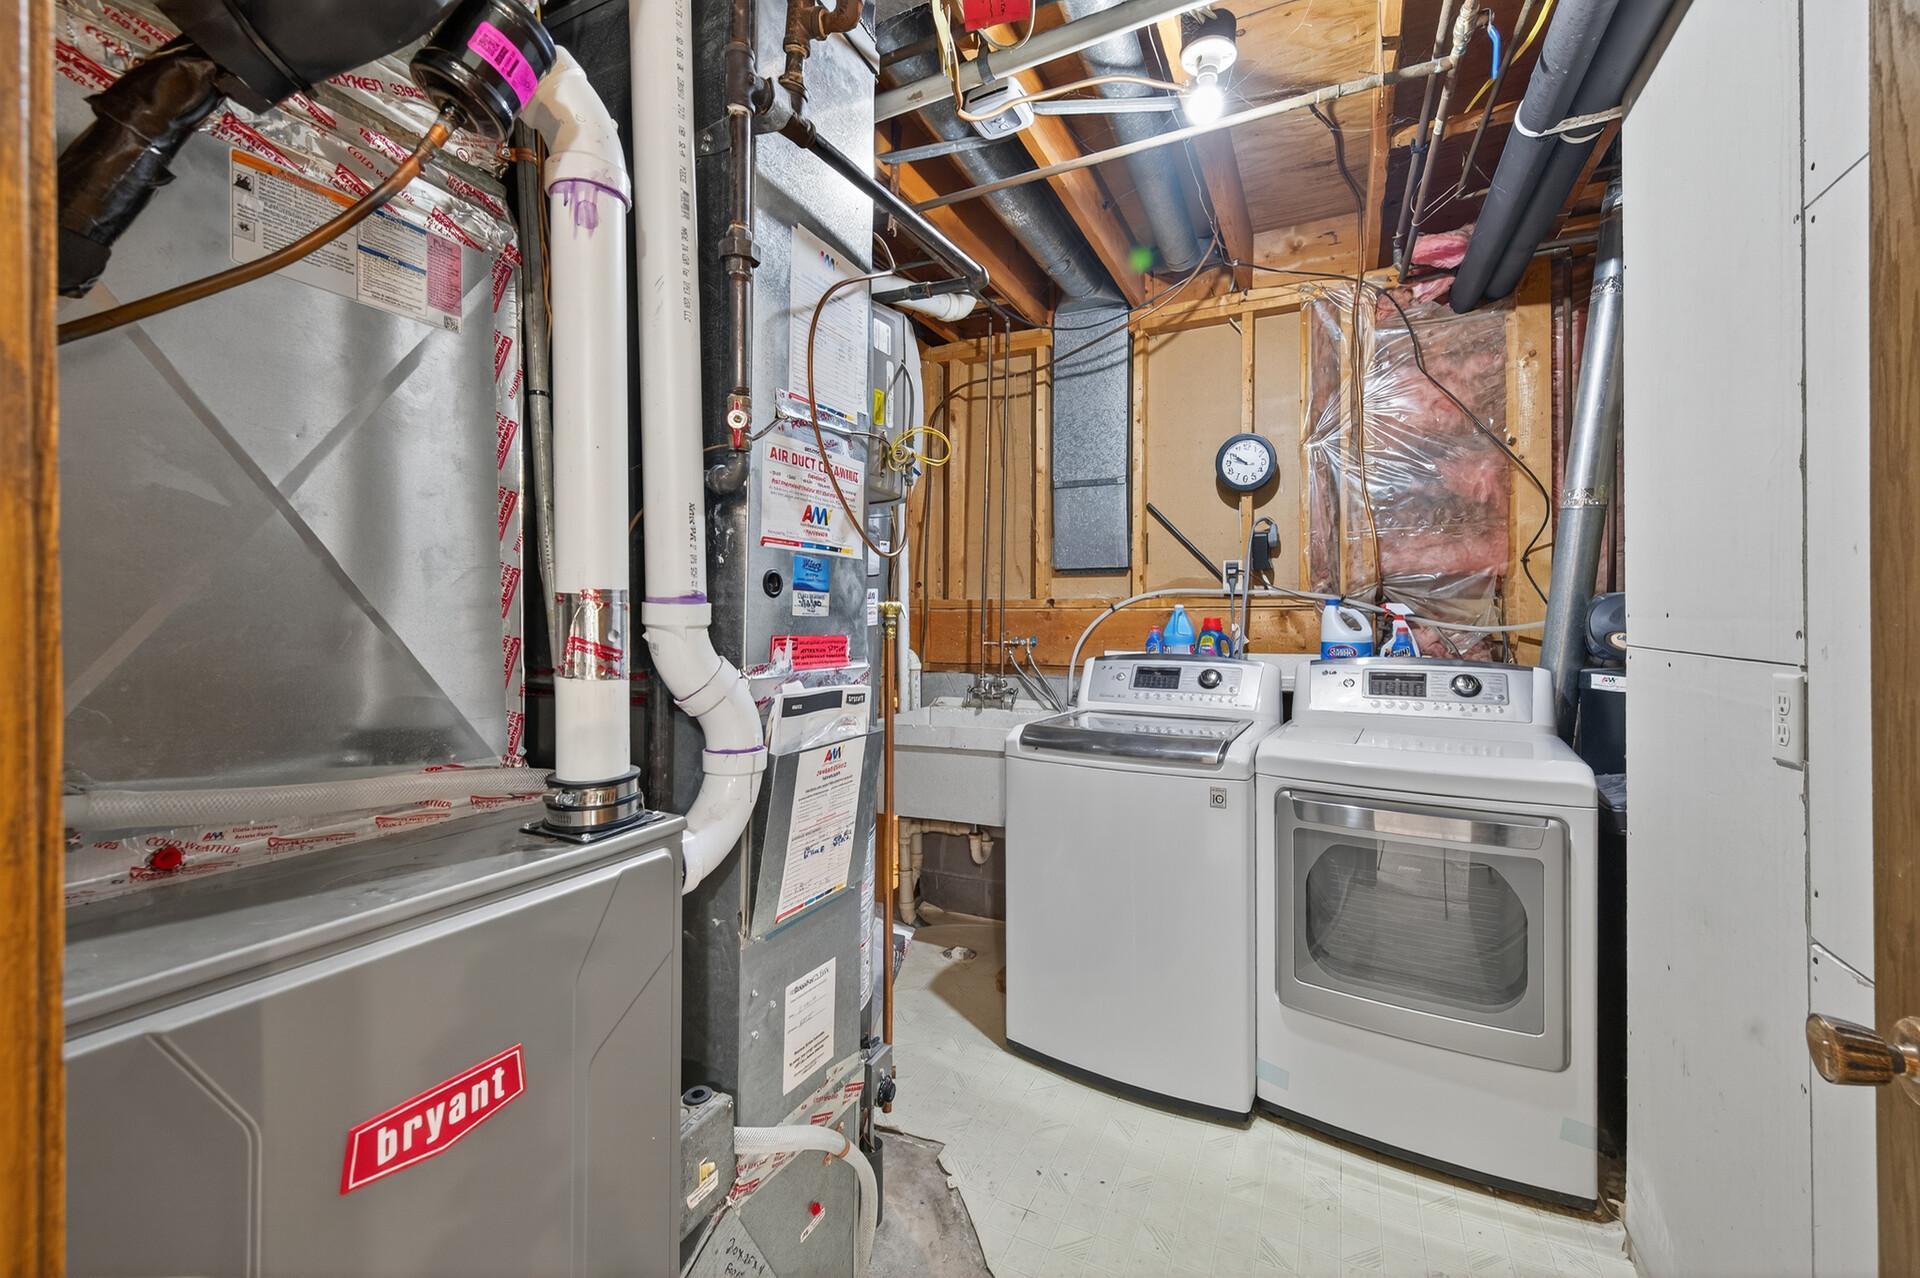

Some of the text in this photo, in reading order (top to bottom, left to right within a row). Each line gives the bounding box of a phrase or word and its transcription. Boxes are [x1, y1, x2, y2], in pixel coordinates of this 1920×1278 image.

[769, 446, 789, 463] AIR
[791, 452, 817, 470] DUCT
[377, 1066, 505, 1167] bryant
